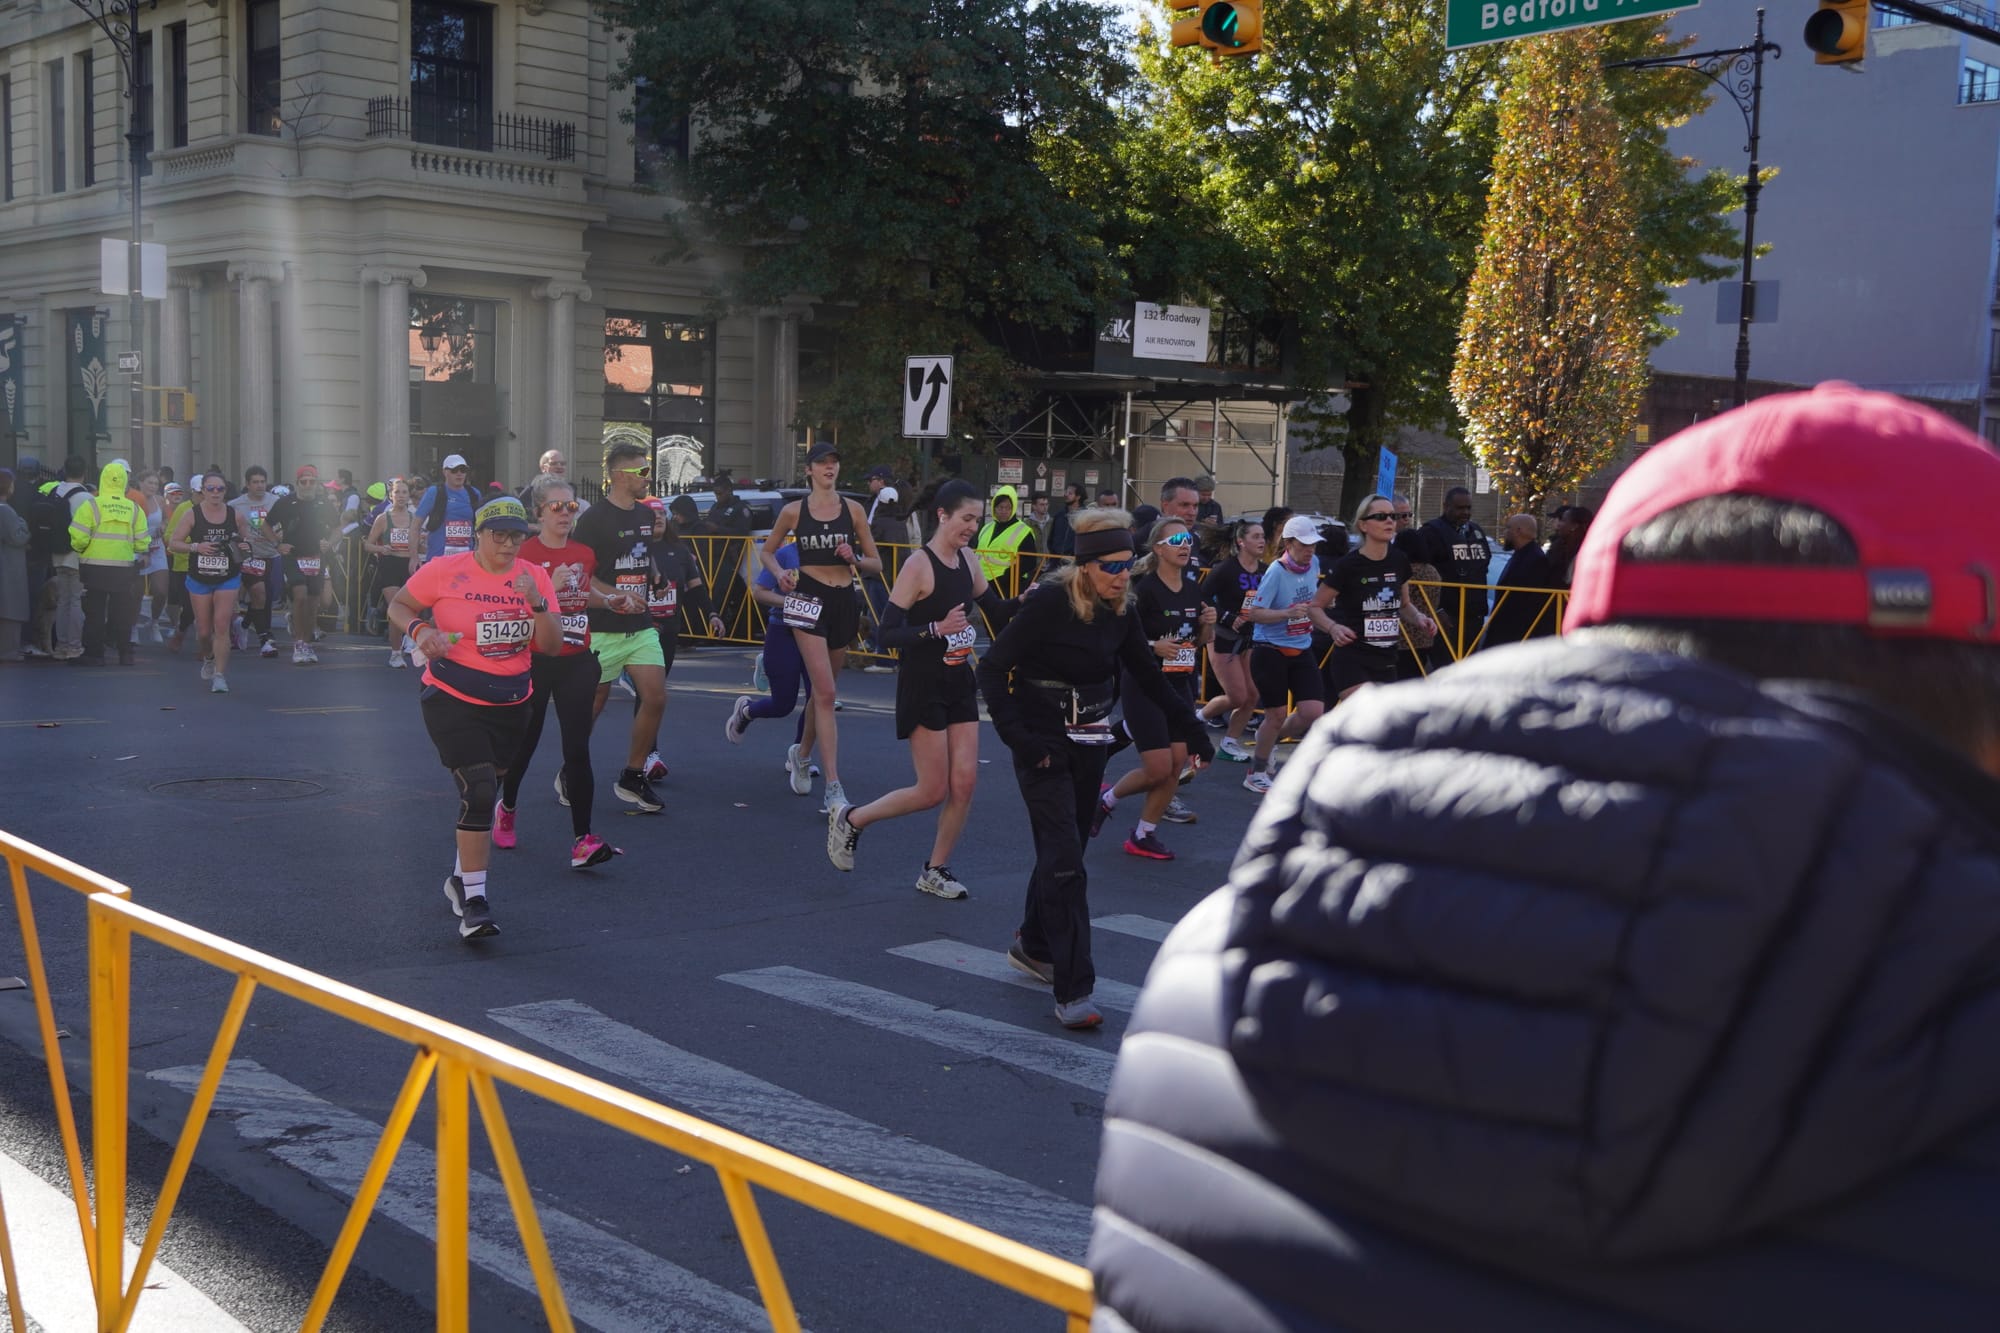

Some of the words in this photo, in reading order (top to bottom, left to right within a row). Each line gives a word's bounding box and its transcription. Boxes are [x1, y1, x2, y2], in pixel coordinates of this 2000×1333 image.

[1143, 310, 1158, 320] 132
[1160, 311, 1201, 326] Broadway
[1156, 337, 1196, 347] RENOVATION
[1453, 548, 1486, 560] POLICE
[464, 592, 525, 606] CAROLYN
[482, 620, 530, 640] 51420
